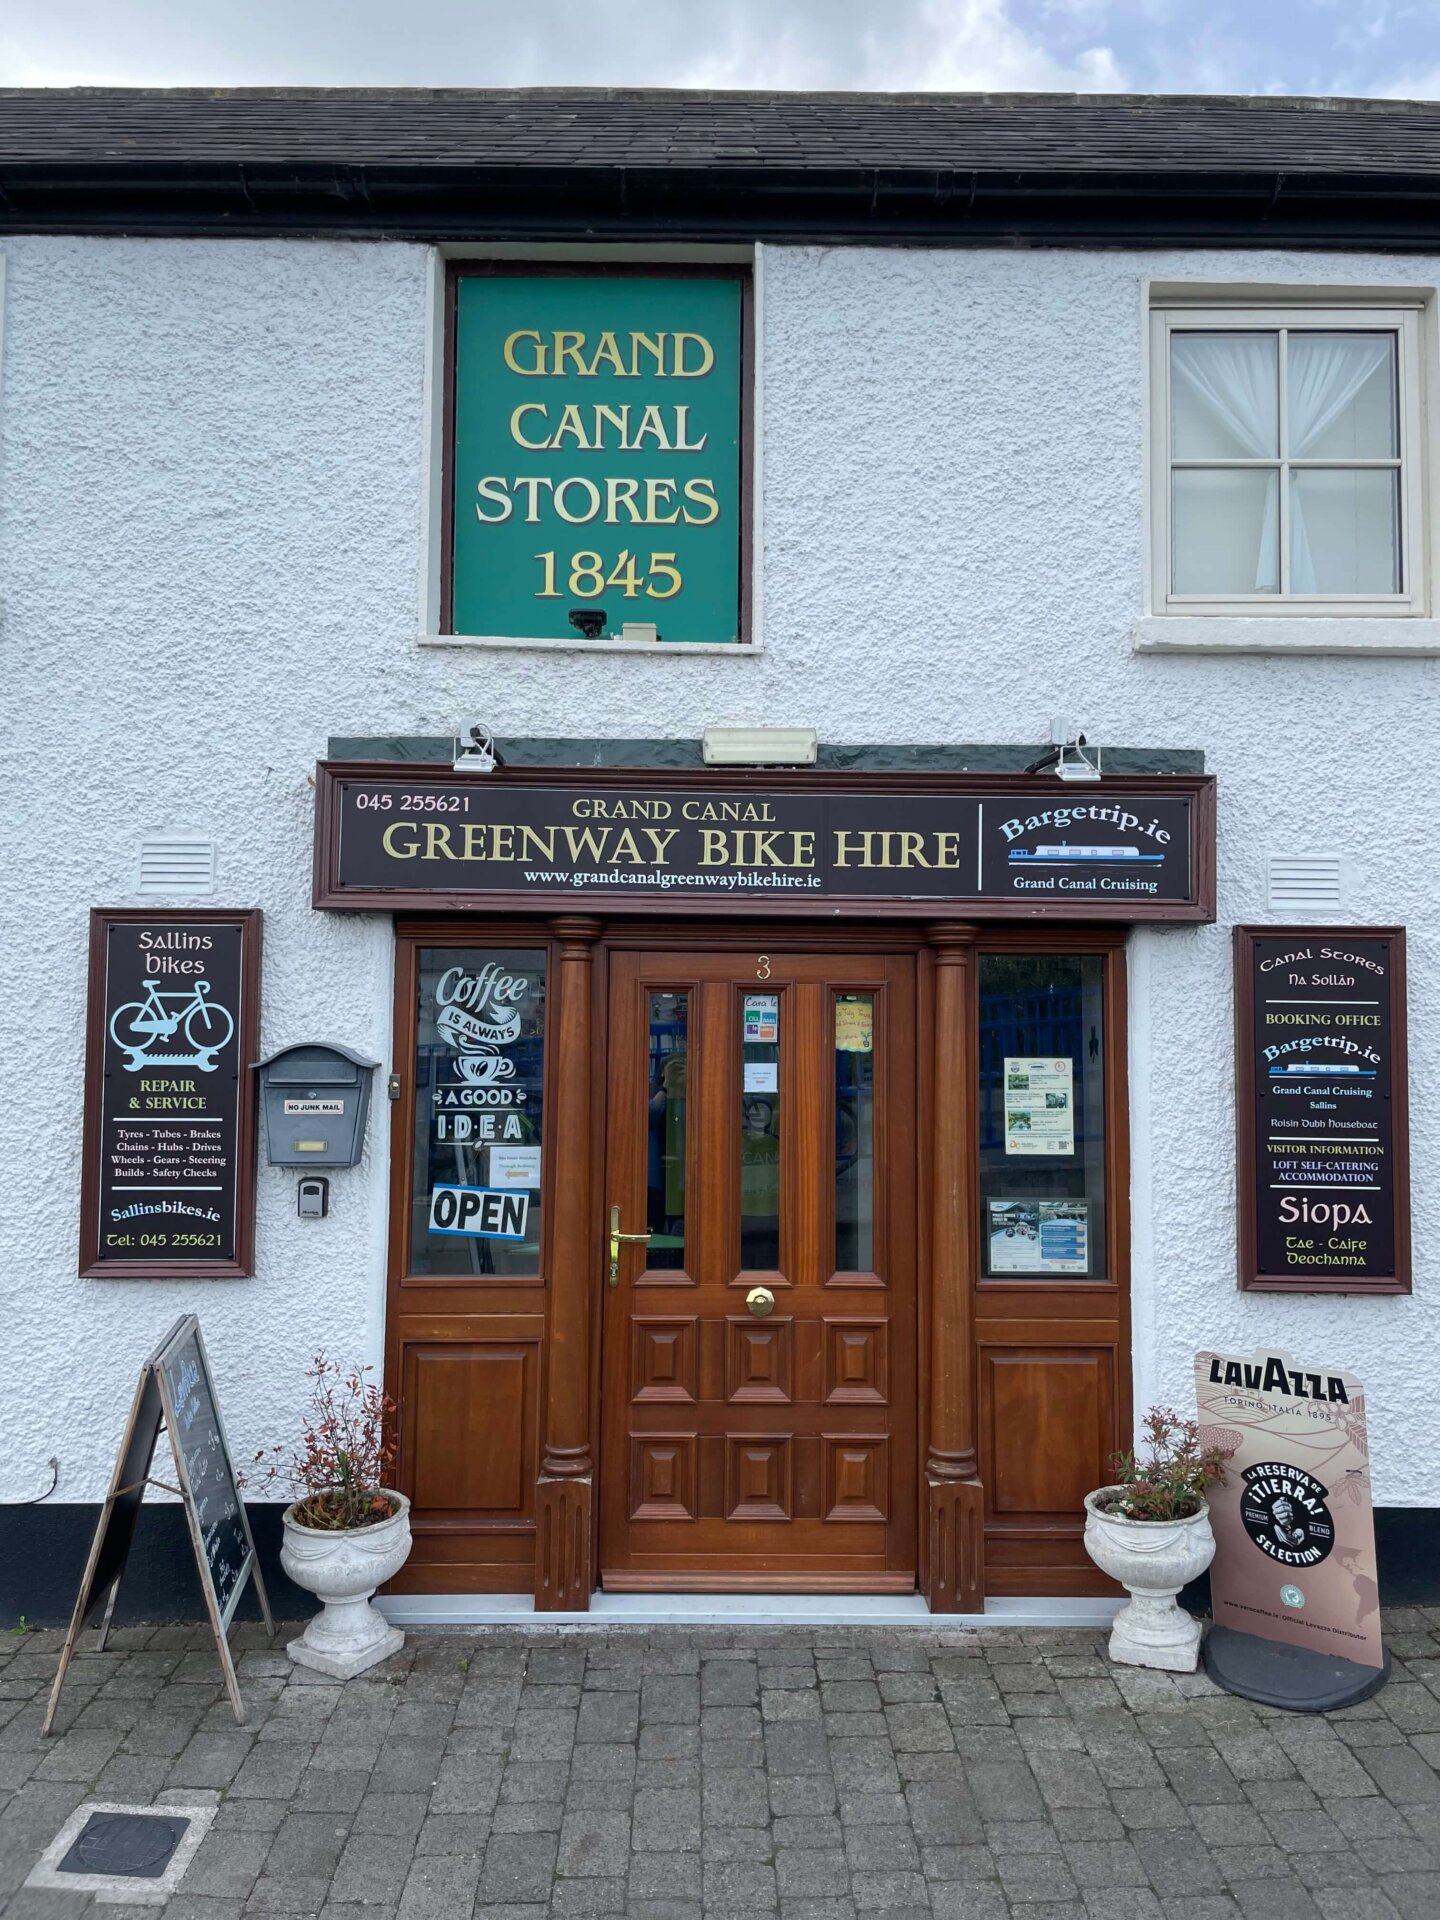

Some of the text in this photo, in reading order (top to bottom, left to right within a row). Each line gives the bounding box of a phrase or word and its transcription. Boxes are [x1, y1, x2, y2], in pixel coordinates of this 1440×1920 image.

[503, 330, 715, 378] GRAND
[510, 403, 708, 451] CANAL
[475, 477, 720, 525] STORES
[534, 549, 683, 598] 1845
[356, 793, 470, 813] 045 255621
[572, 798, 776, 822] GRAND CANAL
[998, 803, 1171, 847] Bargetrip.ie
[382, 821, 960, 869] GREENWAY BIKE HIRE
[524, 869, 822, 889] www.grandcanalgreenwaybikehire.ie
[1013, 876, 1158, 894] Grand Canal Cruising
[138, 931, 213, 951] Sallins
[756, 955, 771, 979] 3
[435, 962, 528, 1013] Coffee
[448, 1011, 515, 1040] IS ALWAYS
[1265, 1013, 1382, 1026] BOOKING OFFICE
[1262, 1035, 1381, 1064] Bargetrip.ie
[140, 1079, 196, 1092] REPAIR
[1272, 1085, 1373, 1098] Grand Canal Cruising
[129, 1096, 207, 1109] & SERVICE
[445, 1089, 513, 1105] A GOOD
[1309, 1101, 1337, 1110] Sallins
[117, 1129, 144, 1140] Tyres
[152, 1129, 181, 1138] Tubes
[190, 1129, 221, 1139] Brakes
[116, 1142, 149, 1151] Chains
[157, 1142, 184, 1151] Hubs
[192, 1142, 222, 1151] Drives
[1266, 1144, 1385, 1155] VISITOR INFORMATION
[111, 1155, 145, 1164] Wheels
[153, 1155, 180, 1164] Gears
[188, 1155, 227, 1167] Steering
[1273, 1160, 1379, 1171] LOFT SELF-CATERING
[114, 1168, 144, 1177] Builds
[152, 1168, 181, 1179] Safety
[183, 1168, 217, 1177] Checks
[1278, 1172, 1374, 1182] ACCOMMODATION
[111, 1200, 221, 1222] Sallinsbikes.ie
[434, 1190, 526, 1235] OPEN
[1278, 1196, 1373, 1232] Siopa
[106, 1234, 222, 1246] Tel: 045 255621
[1209, 1357, 1350, 1405] LAVAZZA
[1224, 1396, 1264, 1409] TORINO
[1307, 1410, 1332, 1421] 1895
[1246, 1464, 1323, 1494] LA RESERVA DE
[1308, 1524, 1331, 1536] BLEND
[1256, 1534, 1322, 1564] SELECTION
